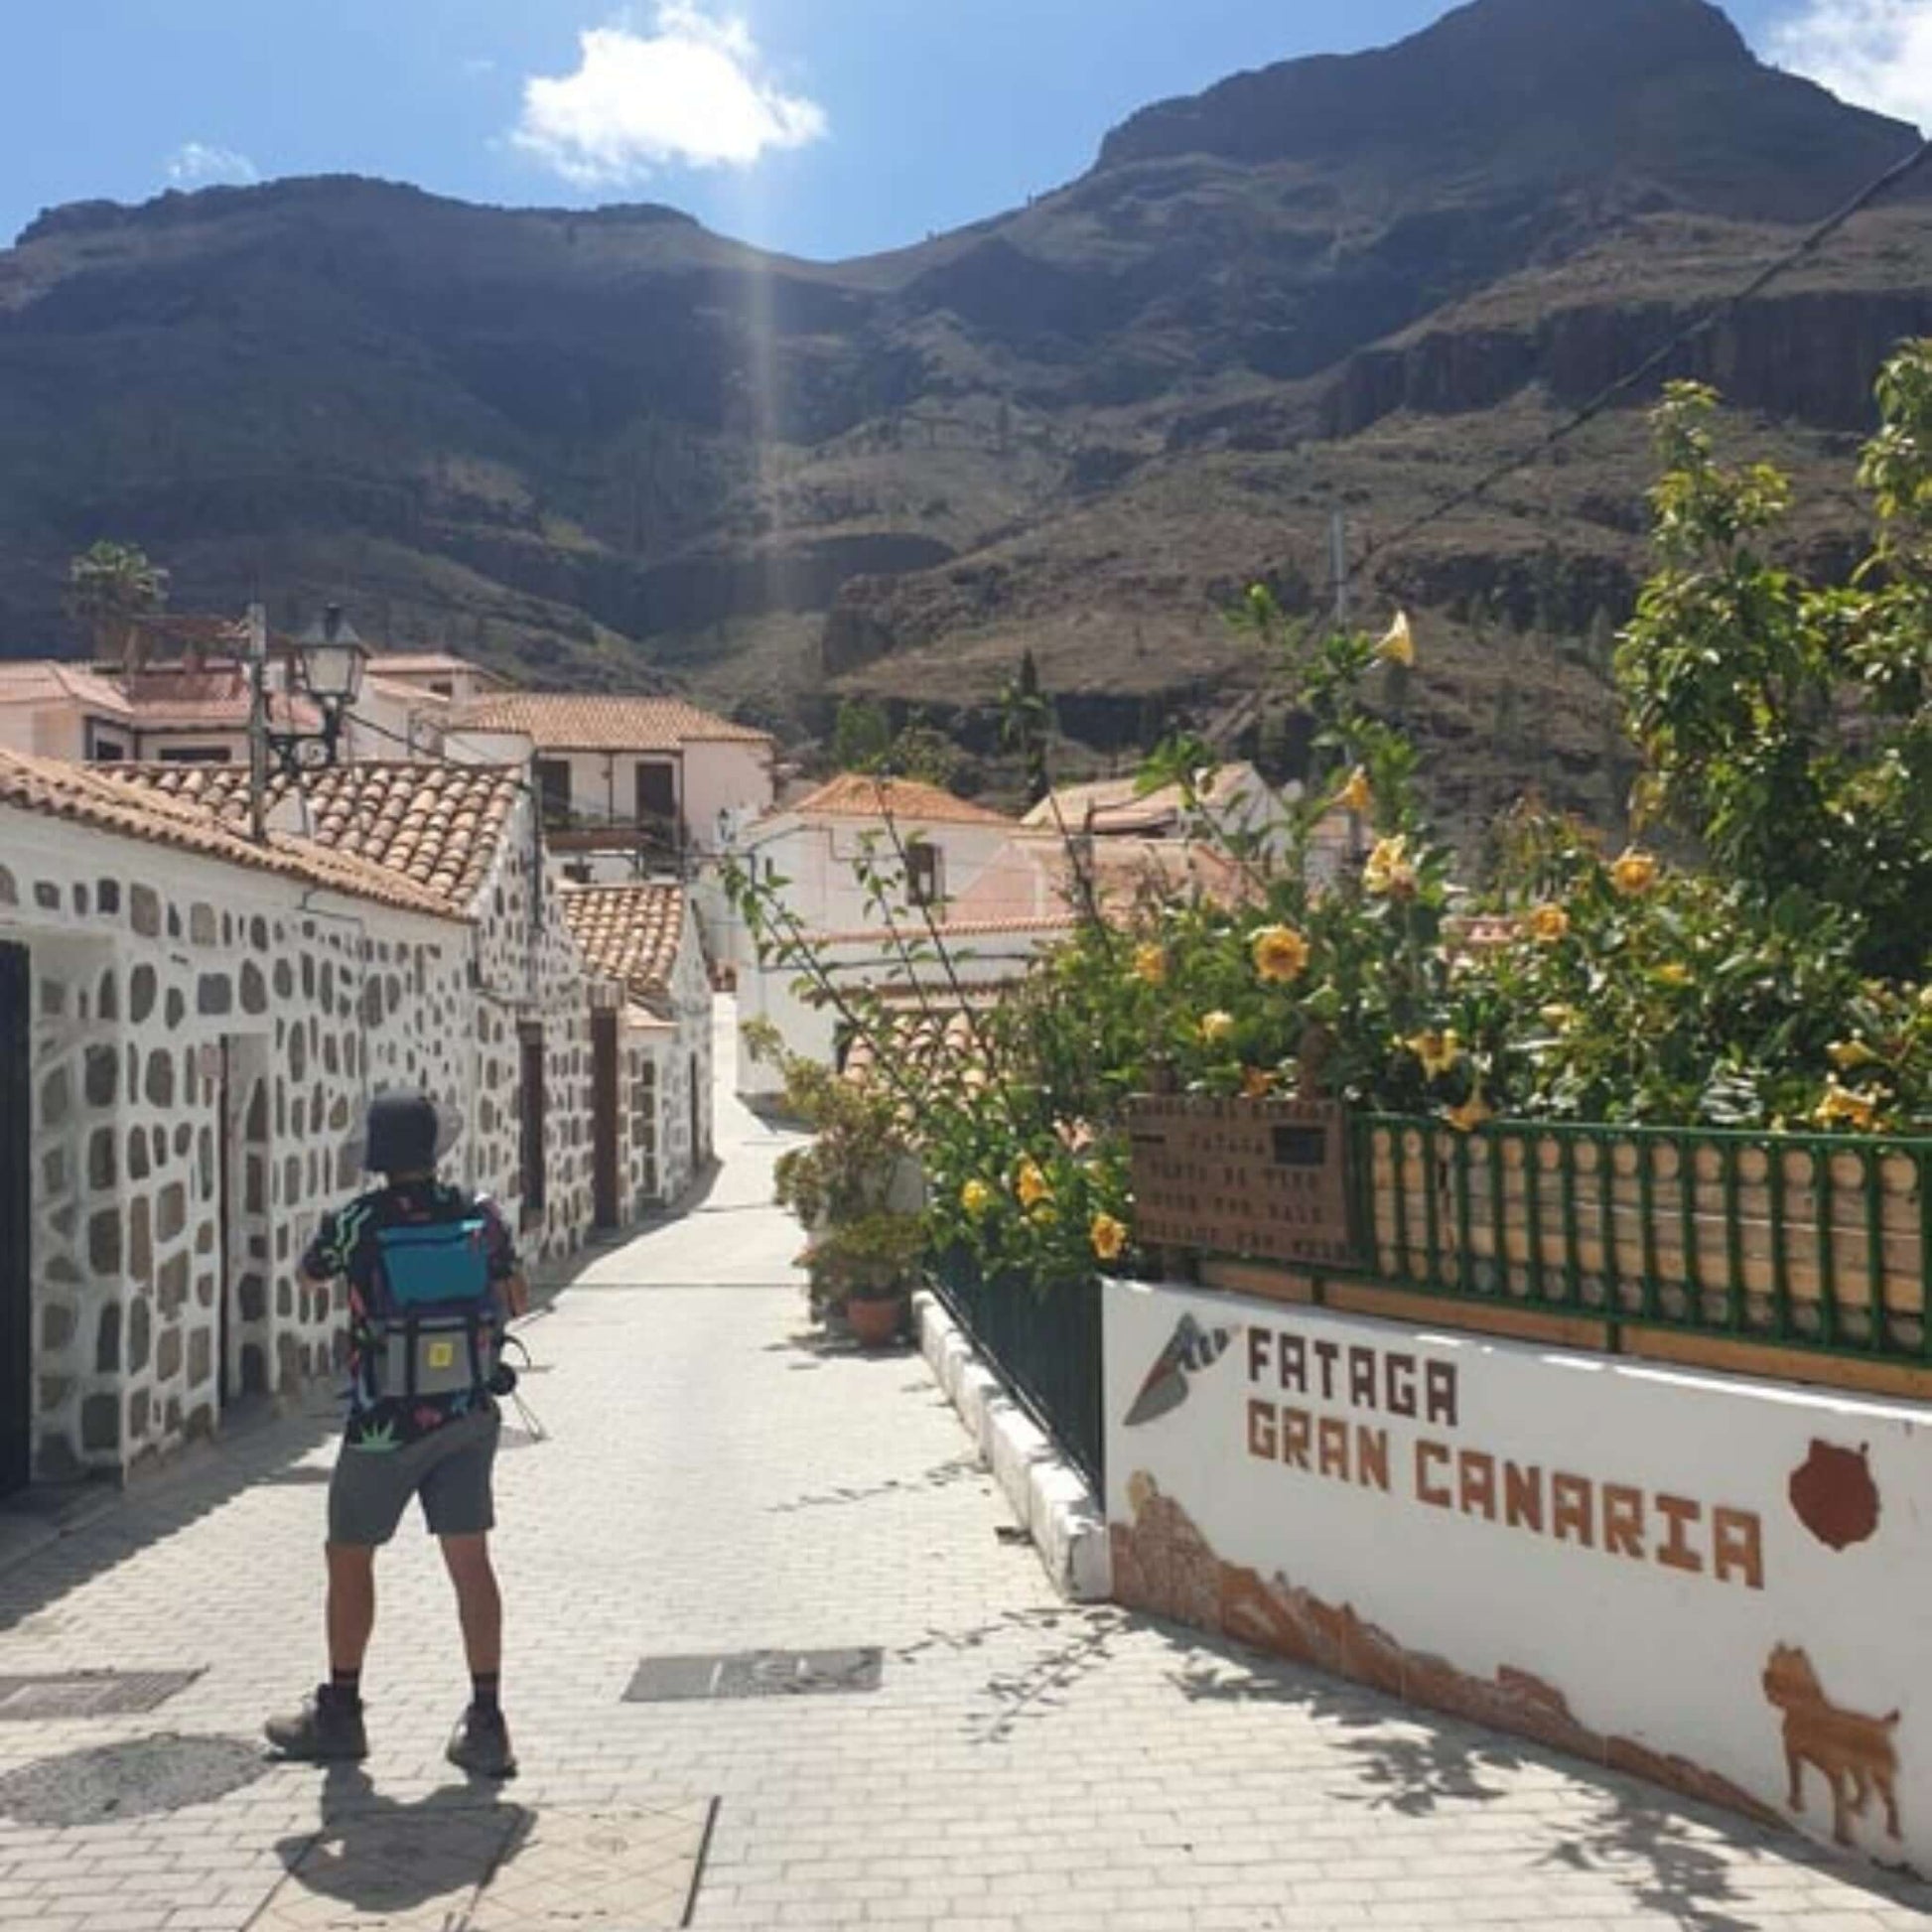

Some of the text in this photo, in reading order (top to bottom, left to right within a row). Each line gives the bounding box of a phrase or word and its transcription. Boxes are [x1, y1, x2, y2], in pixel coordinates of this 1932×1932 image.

[1247, 1325, 1457, 1427] FATAGA
[1247, 1399, 1765, 1590] GRAN CANARIA
